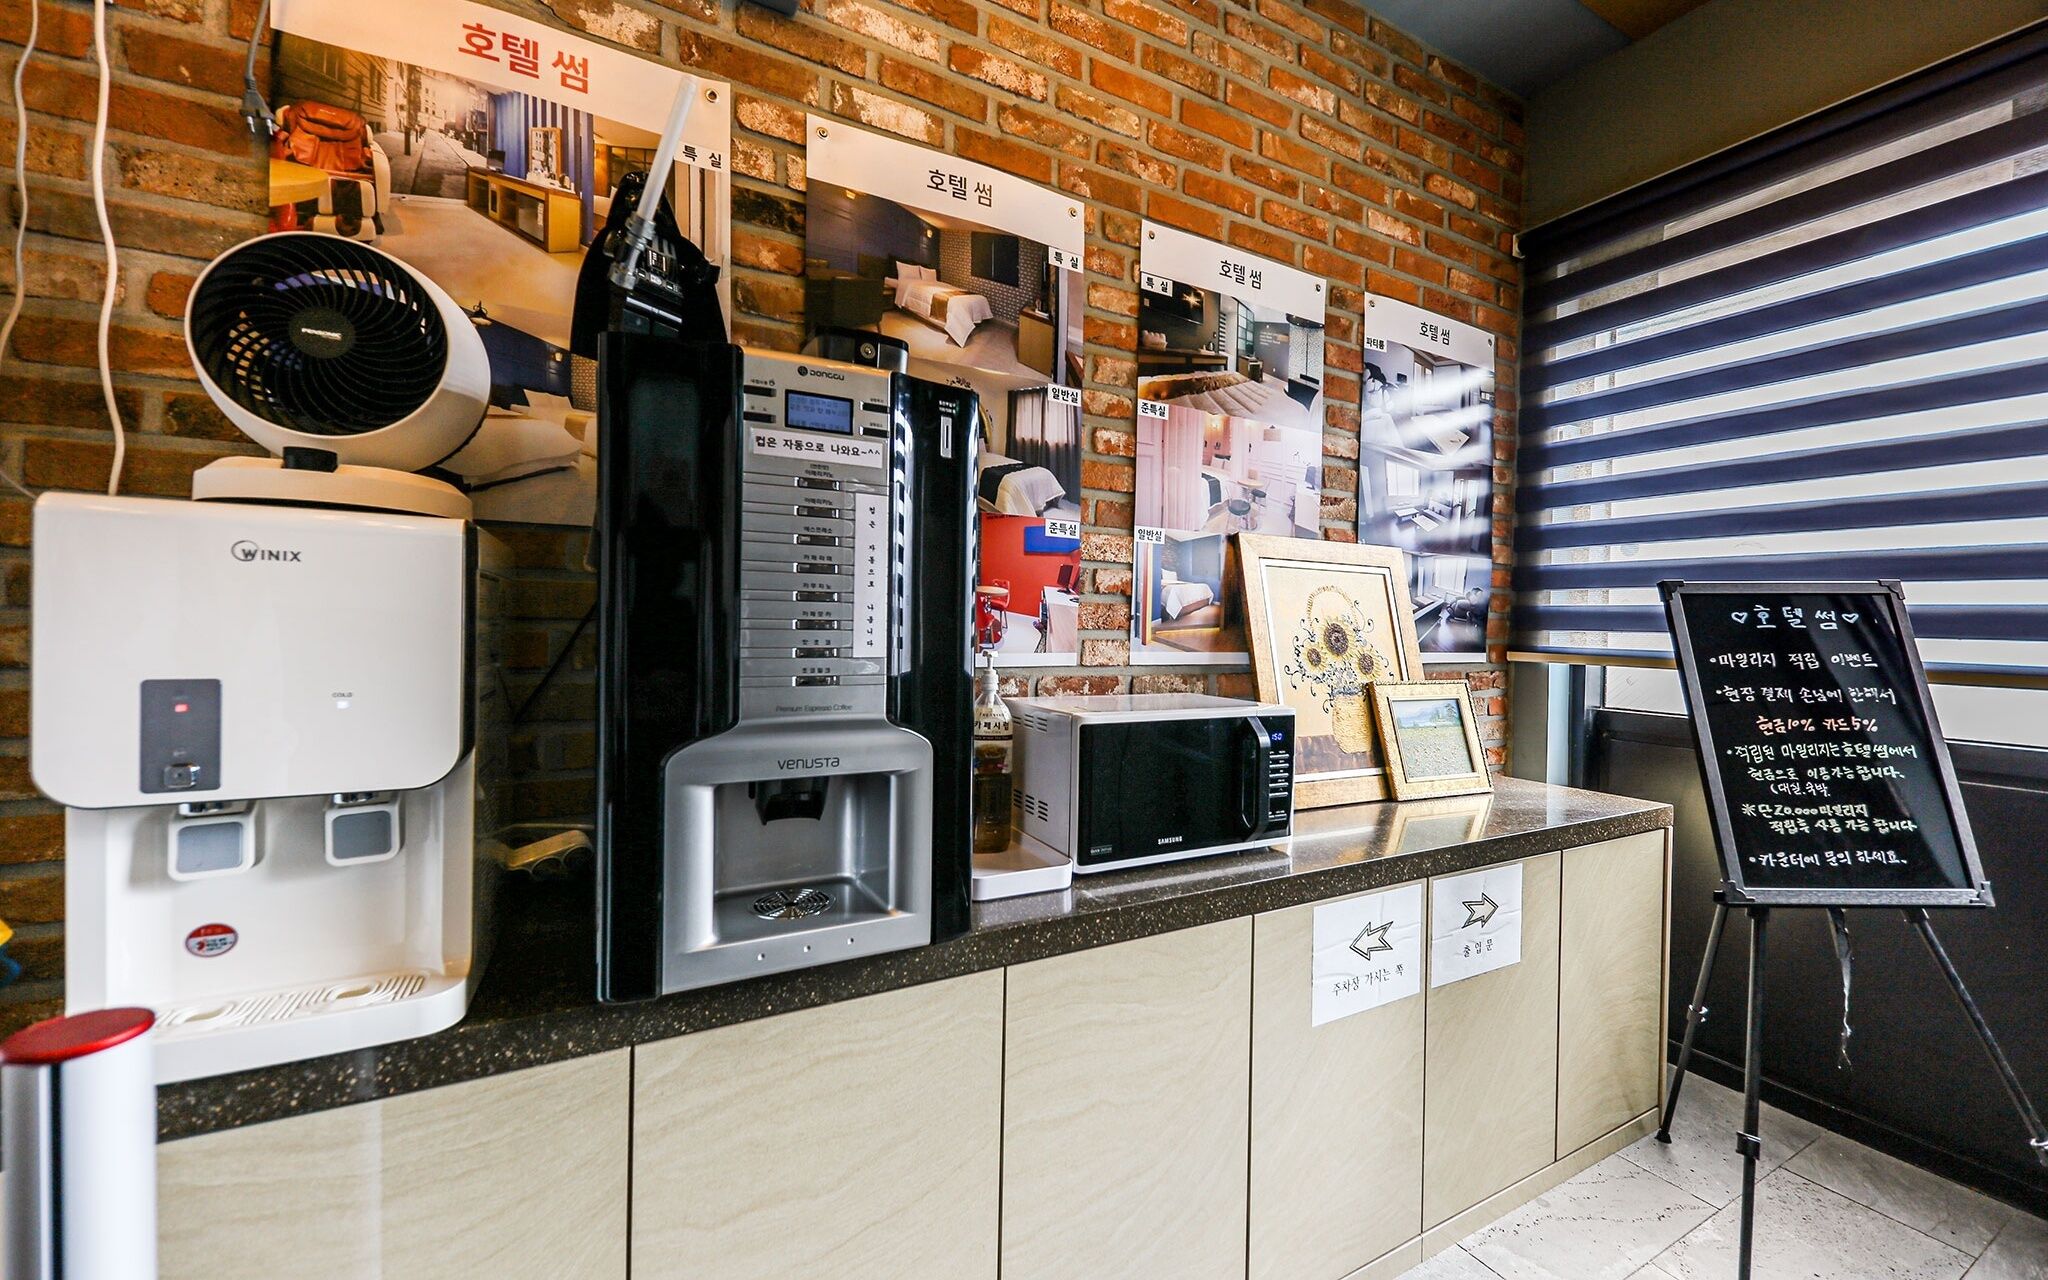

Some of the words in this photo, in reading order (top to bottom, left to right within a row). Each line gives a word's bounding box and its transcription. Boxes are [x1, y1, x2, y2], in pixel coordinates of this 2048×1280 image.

[458, 22, 540, 79] 호텔
[551, 50, 589, 94] 썸
[926, 168, 967, 201] 호텔
[973, 182, 993, 208] 썸
[1218, 259, 1246, 285] 호텔
[1249, 269, 1262, 290] 썸
[1419, 321, 1439, 342] 호텔
[1440, 328, 1450, 346] 썸
[1366, 337, 1385, 350] 파티룸
[1051, 387, 1079, 403] 일반실
[1140, 402, 1166, 418] 준특실
[755, 435, 777, 448] 컵은
[783, 439, 825, 453] 자동으로
[1049, 521, 1077, 537] 준특실
[1137, 528, 1164, 543] 일반실
[231, 541, 302, 562] WINIX
[1814, 609, 1838, 630] 썸
[1718, 652, 1776, 668] 마일리지
[1788, 652, 1820, 670] 적립
[1831, 652, 1878, 668] 이벤트
[1722, 685, 1755, 702] 현장
[1761, 687, 1794, 703] 결제
[1799, 687, 1843, 704] 손님에
[1848, 686, 1897, 705] 한해서
[1734, 744, 1775, 764] 적립된
[1747, 766, 1799, 781] 현금으로
[1814, 818, 1842, 834] 사용
[1157, 835, 1183, 845] SAMSUNG
[1758, 851, 1821, 868] 카운터에
[1824, 850, 1852, 867] 문의
[1463, 938, 1494, 958] 출입문
[1331, 976, 1360, 996] 주차장
[1364, 968, 1391, 986] 가시는
